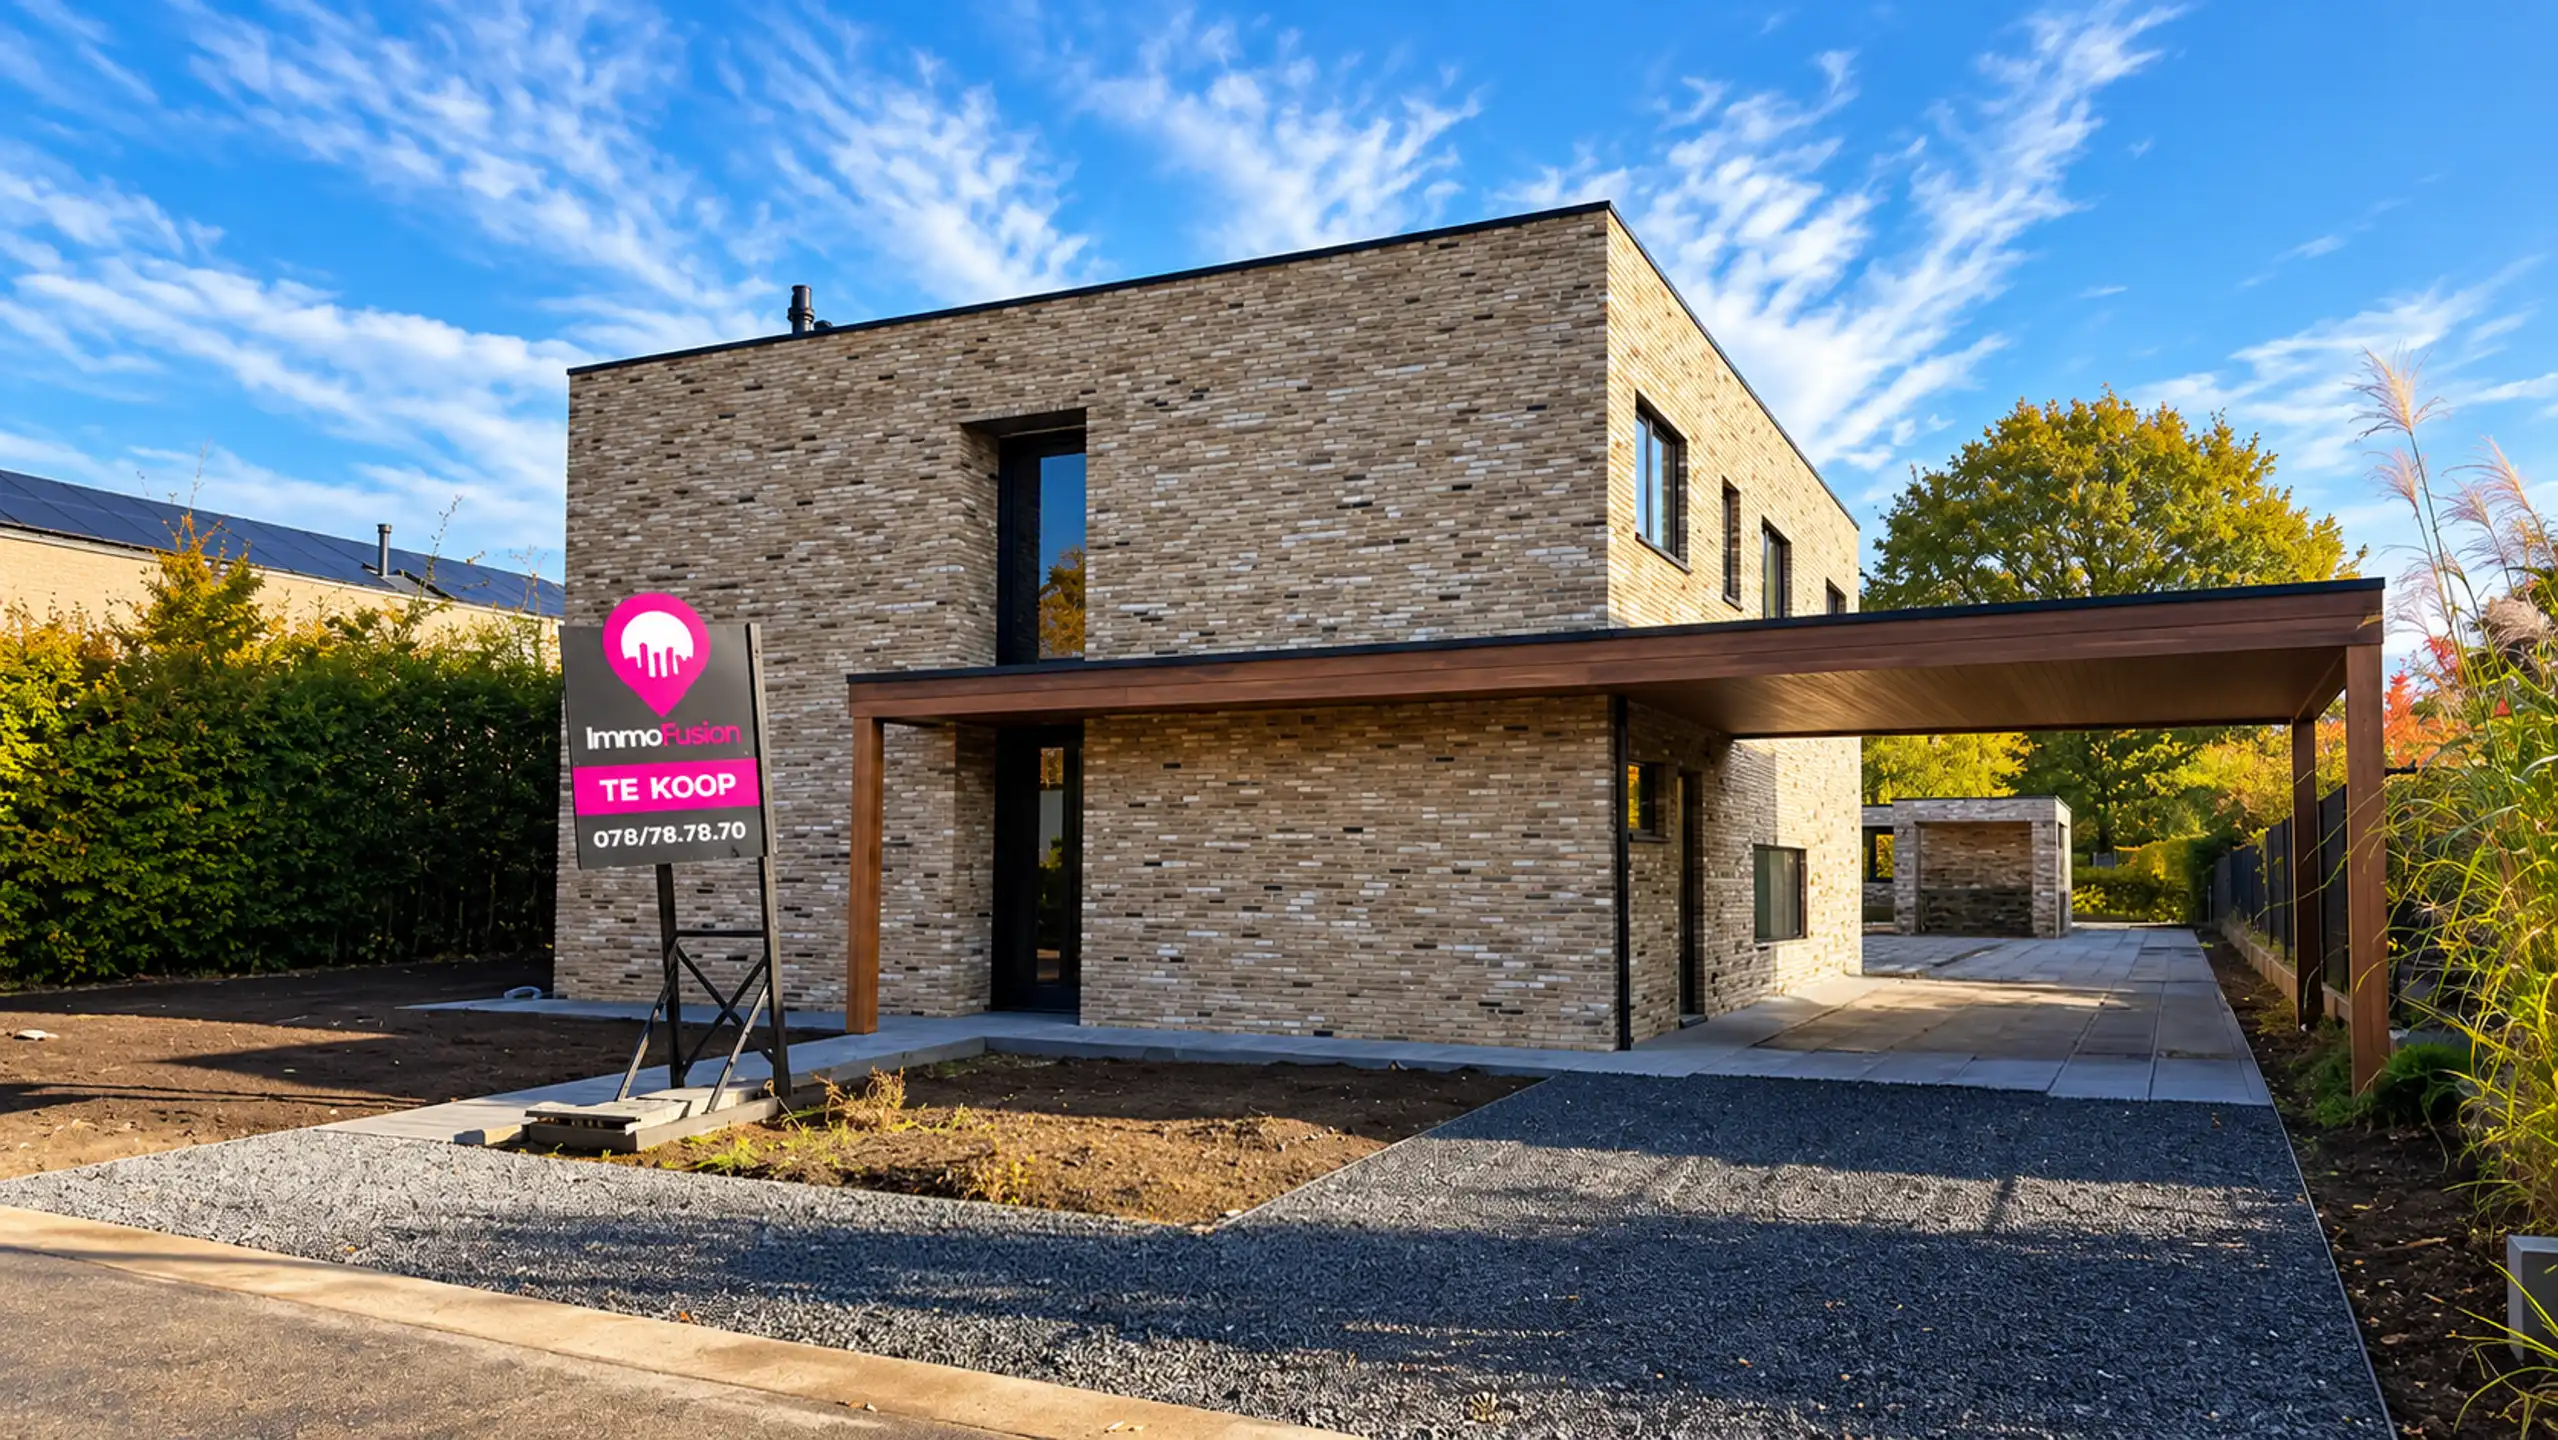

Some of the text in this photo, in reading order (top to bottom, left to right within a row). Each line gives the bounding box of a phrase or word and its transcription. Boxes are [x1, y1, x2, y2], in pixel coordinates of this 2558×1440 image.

[585, 720, 742, 750] ImmoFusion
[599, 773, 736, 802] TE KOOP
[593, 821, 746, 848] 078/78.78.70
